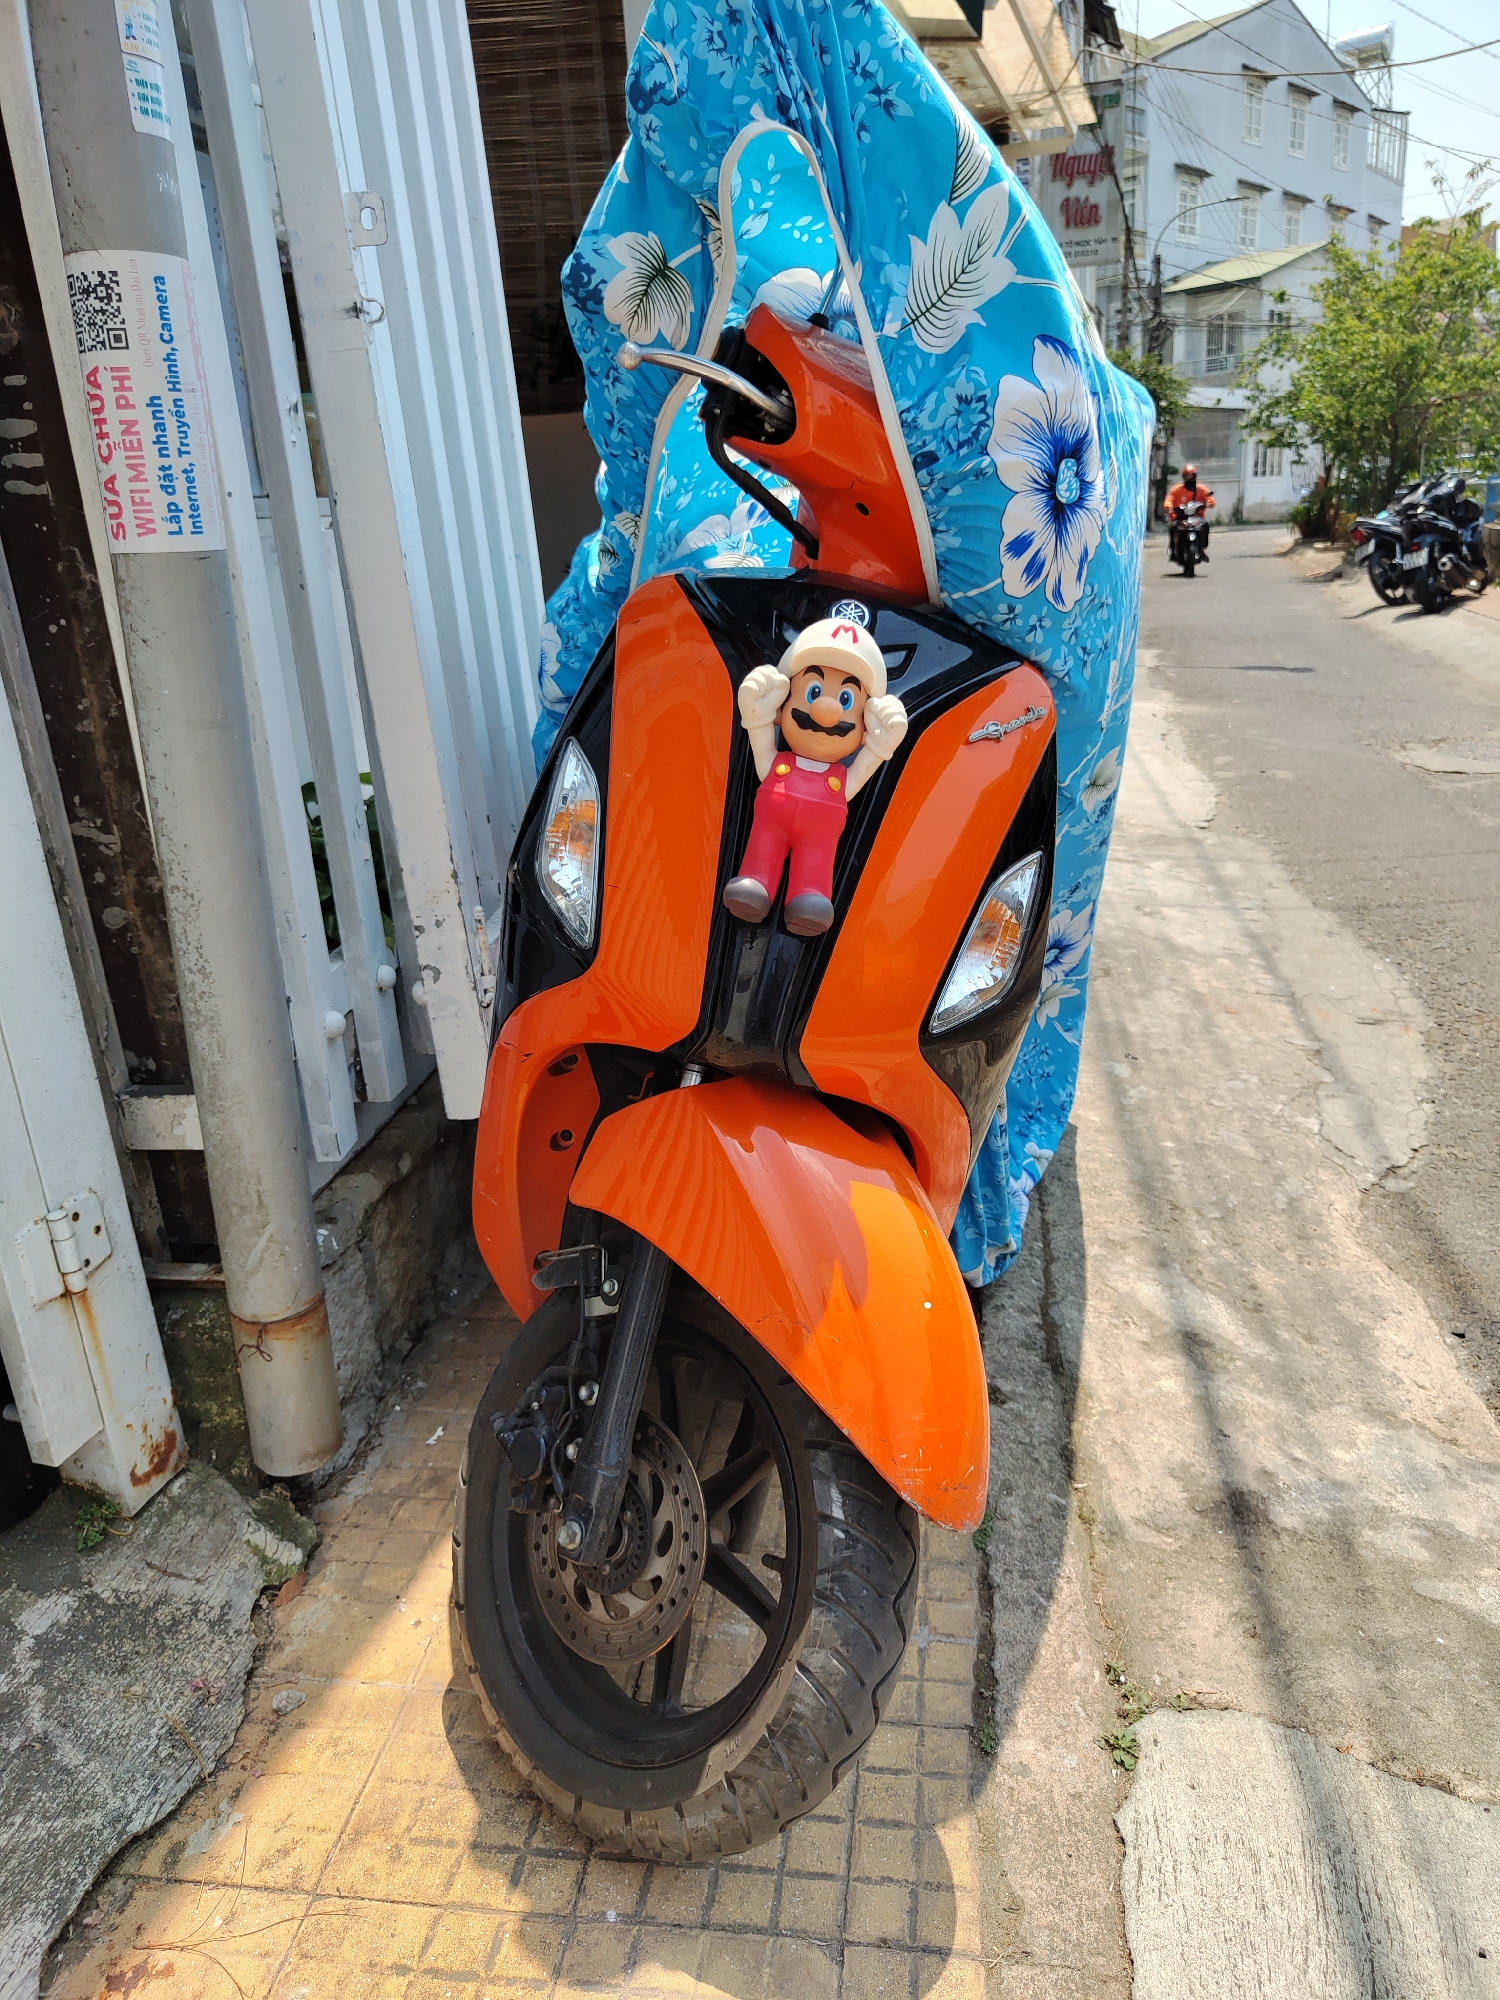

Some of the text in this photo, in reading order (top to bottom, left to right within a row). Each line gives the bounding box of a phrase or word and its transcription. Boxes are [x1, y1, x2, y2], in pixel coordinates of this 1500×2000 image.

[138, 332, 151, 346] QR
[103, 366, 159, 539] WIFI MIỄN PHÍ
[153, 275, 205, 536] Internet, Truyền Hình, Camera
[103, 473, 127, 541] SỬA
[146, 395, 184, 536] Lắp đặt nhanh
[831, 624, 859, 645] M
